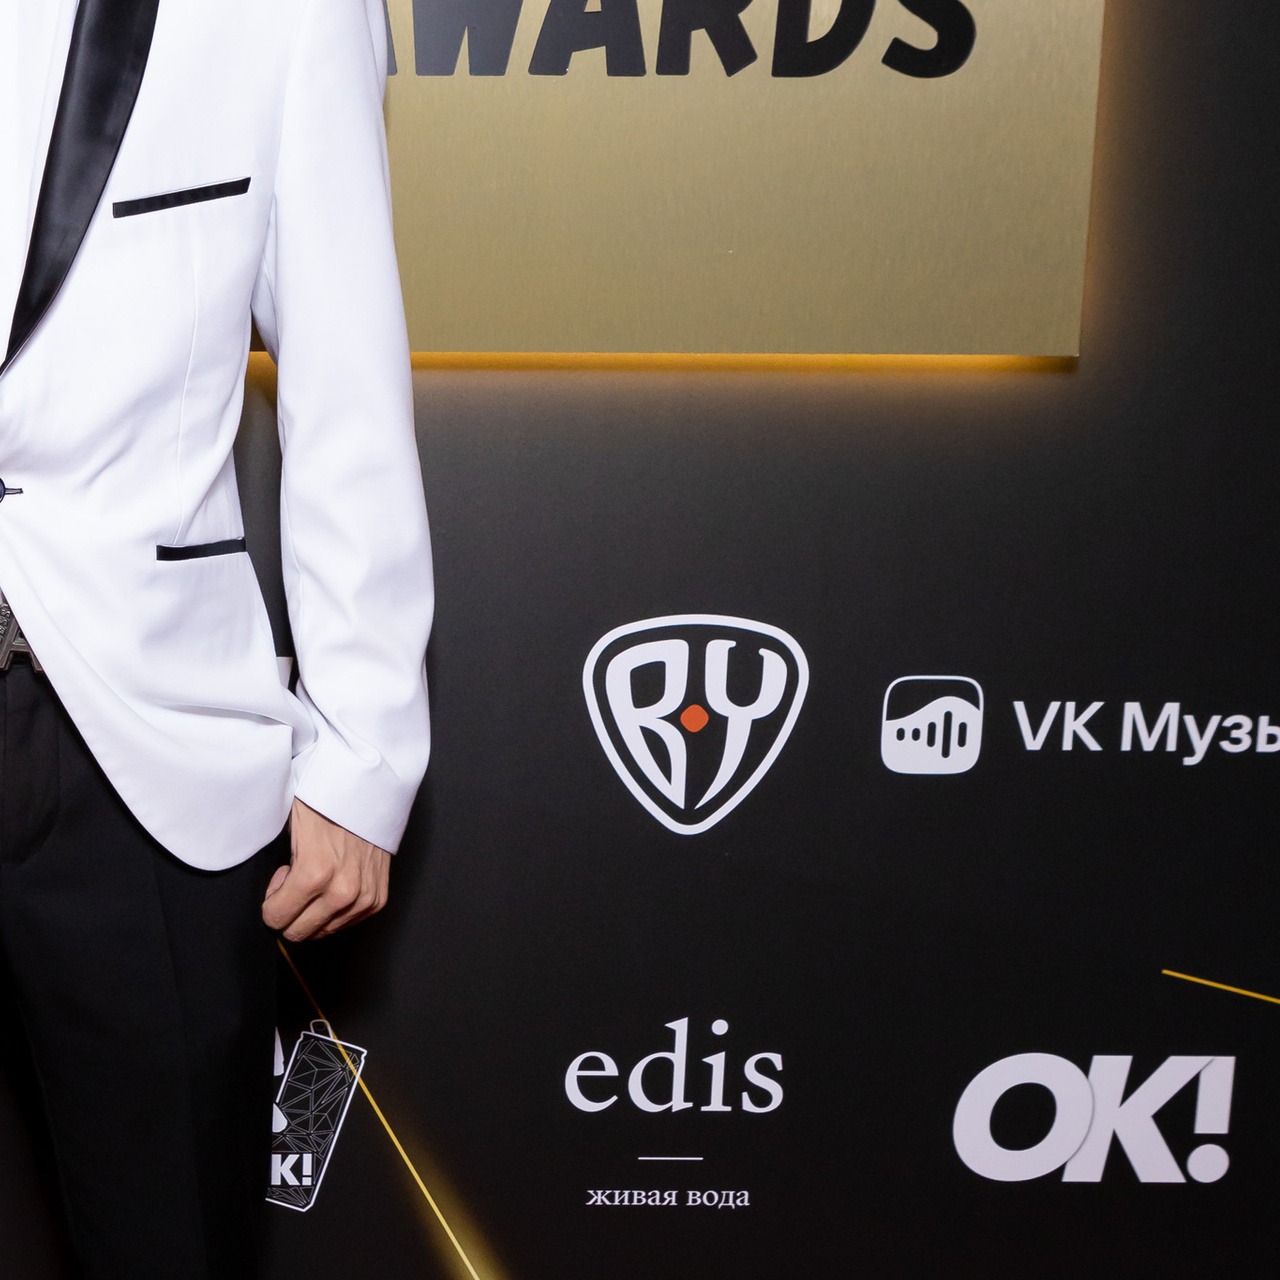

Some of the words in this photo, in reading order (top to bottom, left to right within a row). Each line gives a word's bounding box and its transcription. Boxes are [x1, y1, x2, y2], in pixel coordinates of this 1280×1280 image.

[1013, 701, 1104, 751] VK
[565, 1017, 784, 1114] edis
[953, 1053, 1236, 1183] OK!
[586, 1189, 678, 1206] живая
[687, 1190, 750, 1210] вода
